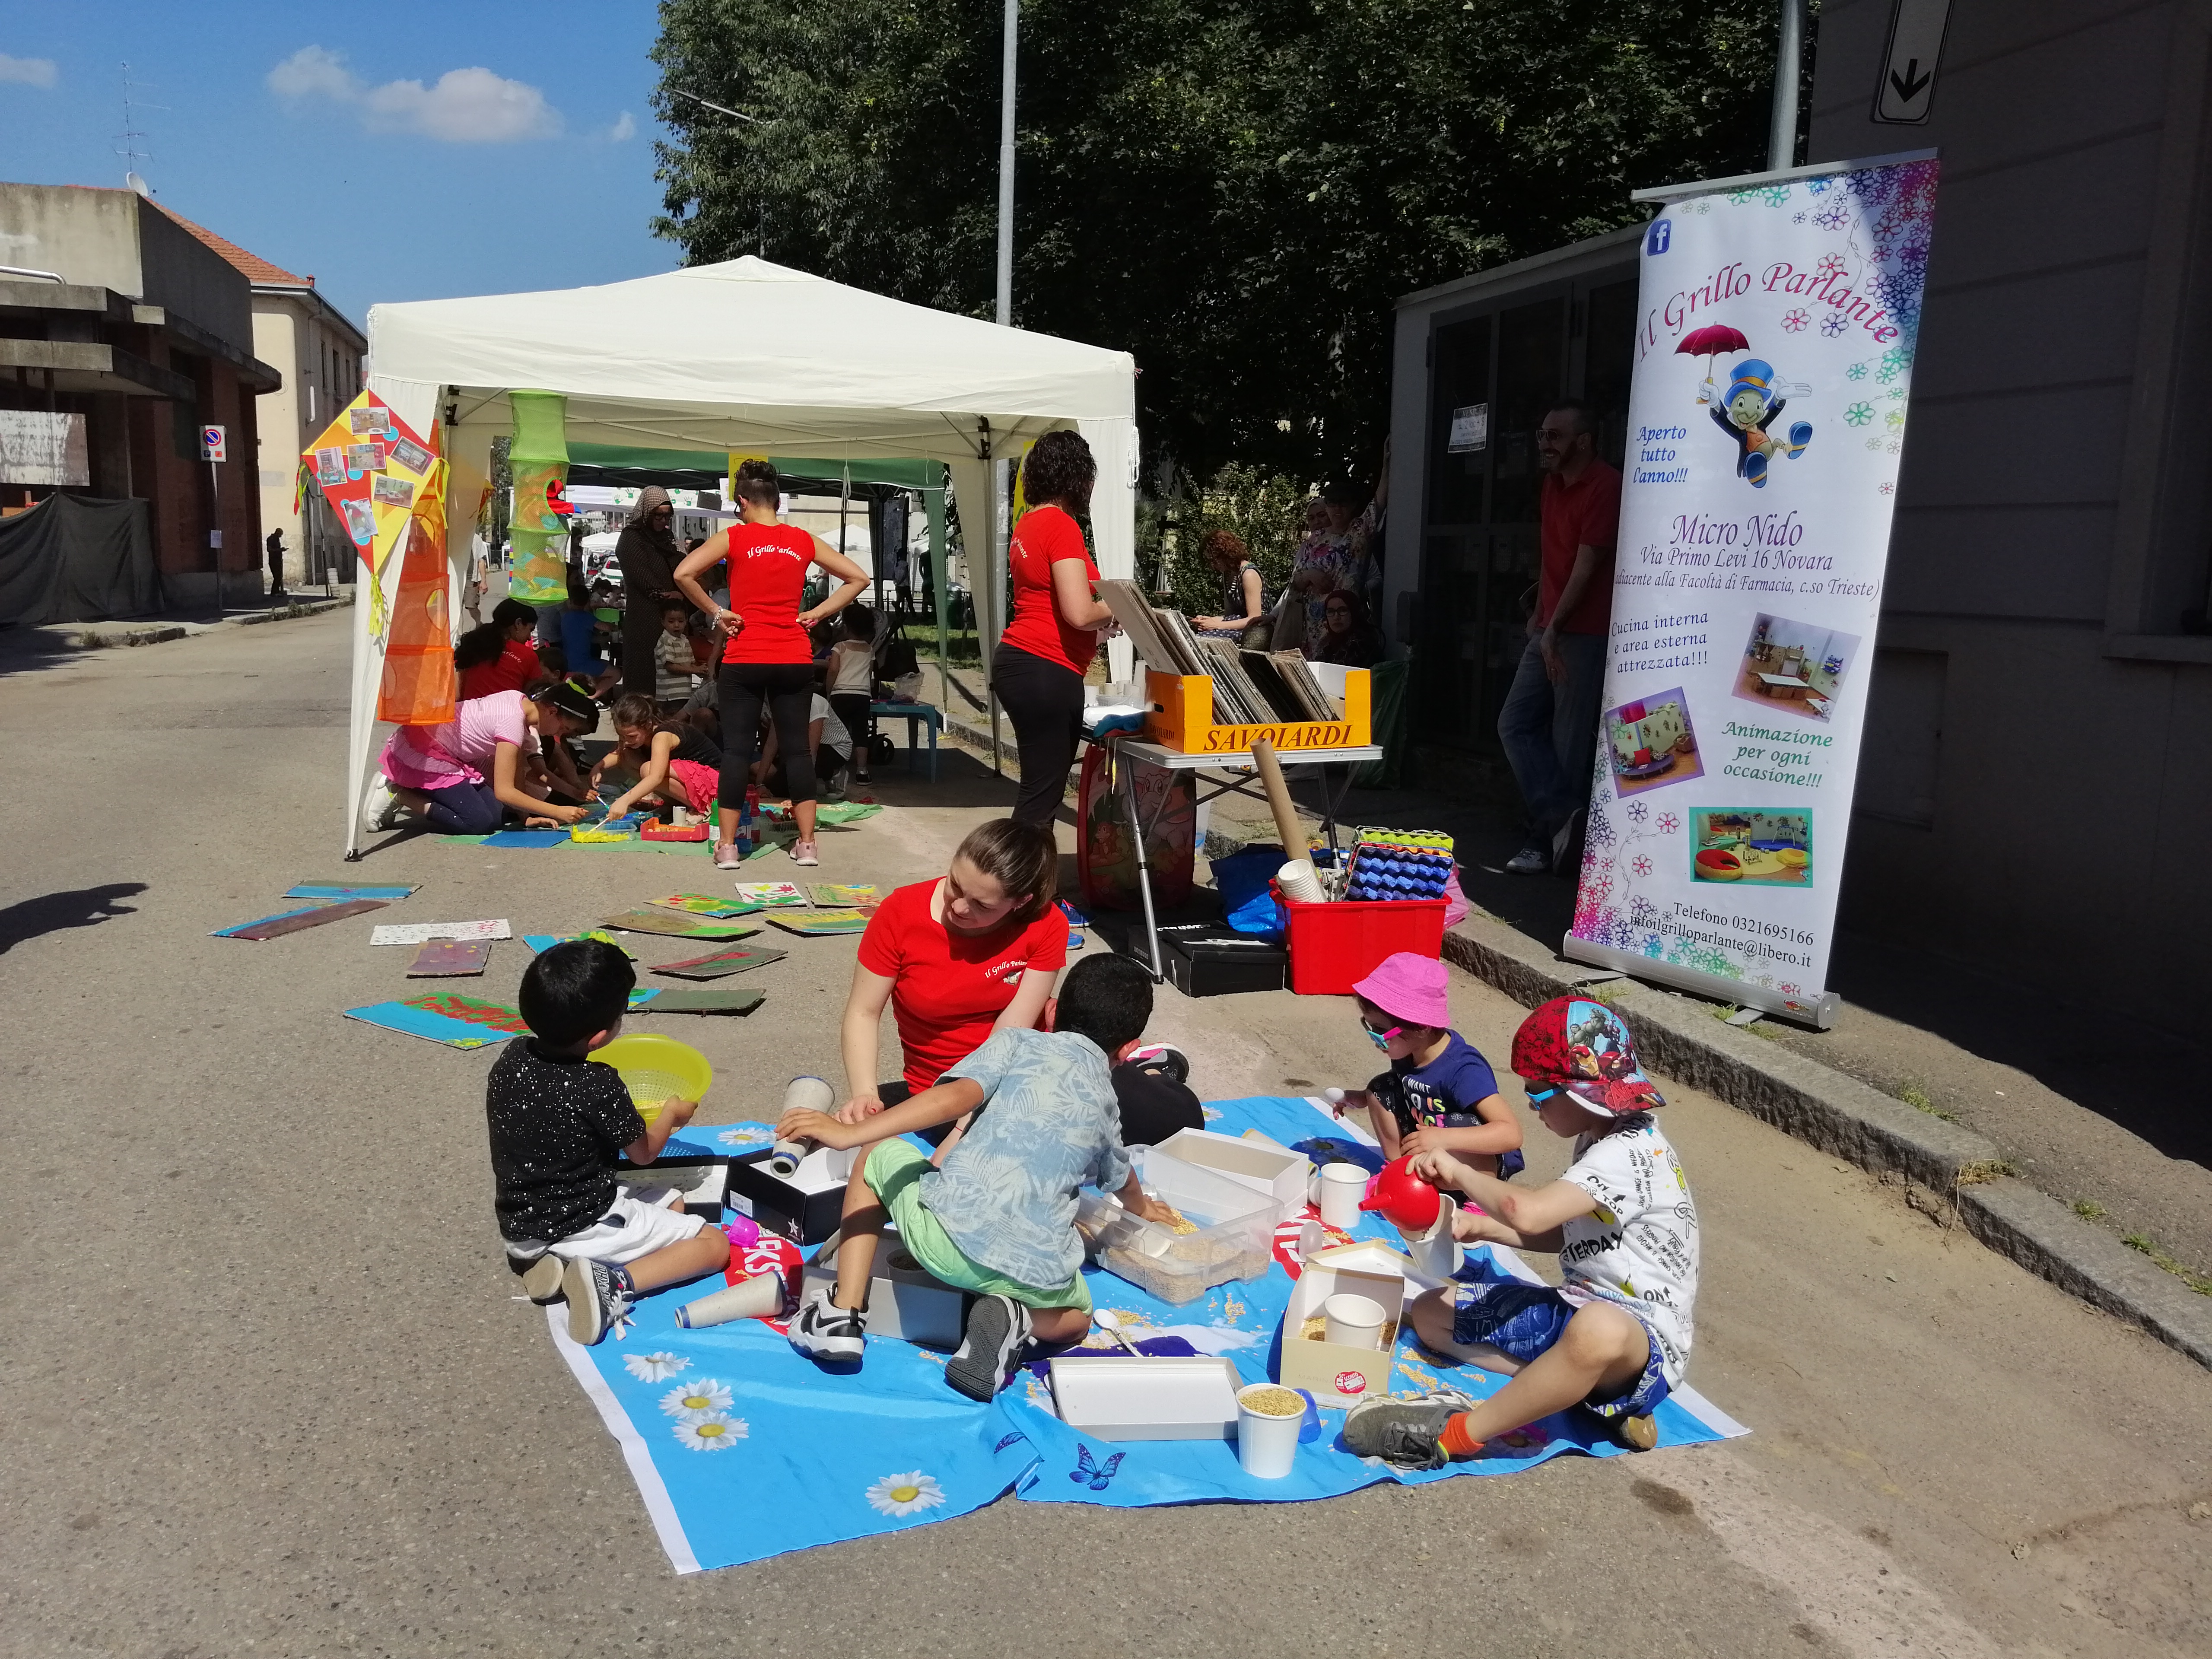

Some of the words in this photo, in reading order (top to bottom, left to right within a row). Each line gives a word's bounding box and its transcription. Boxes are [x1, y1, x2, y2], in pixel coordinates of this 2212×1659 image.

[1639, 309, 1657, 362] Il
[1664, 262, 1751, 336] Grillo
[1762, 262, 1898, 344] Parlante
[1636, 426, 1687, 446] Aperto
[1641, 447, 1676, 462] tutto
[1670, 513, 1738, 546] Micro
[1743, 510, 1803, 547] Nido
[747, 547, 753, 559] Il
[755, 545, 775, 556] Grillo
[1640, 543, 1662, 565] Via
[1668, 547, 1710, 567] Primo
[1714, 548, 1748, 569] Levi
[1752, 550, 1768, 569] 16
[1772, 549, 1833, 572] Novara
[1654, 570, 1675, 587] alla
[1679, 573, 1722, 591] Facoltà
[1725, 573, 1737, 591] di
[1740, 575, 1794, 594] Farmacia,
[1799, 580, 1824, 594] c.so
[1827, 578, 1881, 602] Trieste)
[1611, 618, 1649, 638] Cucina
[1653, 612, 1709, 629] interna
[1614, 642, 1620, 655] e
[1621, 639, 1649, 652] area
[1654, 632, 1708, 649] esterna
[1617, 650, 1709, 674] attrezzata!!!
[1721, 721, 1834, 747] Animazione
[1732, 744, 1766, 762] per
[1771, 750, 1812, 767] ogni
[1723, 763, 1823, 788] occasione!!!
[1673, 902, 1728, 926] Telefono
[1732, 915, 1815, 946] 0321695166
[1630, 915, 1812, 968] infoilgrilloparlante@libero.it
[985, 969, 991, 978] Il
[992, 961, 1010, 976] Grillo
[1408, 1078, 1430, 1094] WANT
[1634, 1178, 1643, 1194] CHANGE
[1603, 1194, 1623, 1215] TOP
[1636, 1235, 1653, 1250] NEEDED
[1641, 1224, 1661, 1245] PROGRESS
[1657, 1256, 1671, 1271] CHANGE
[1344, 1372, 1359, 1382] SCONTO
